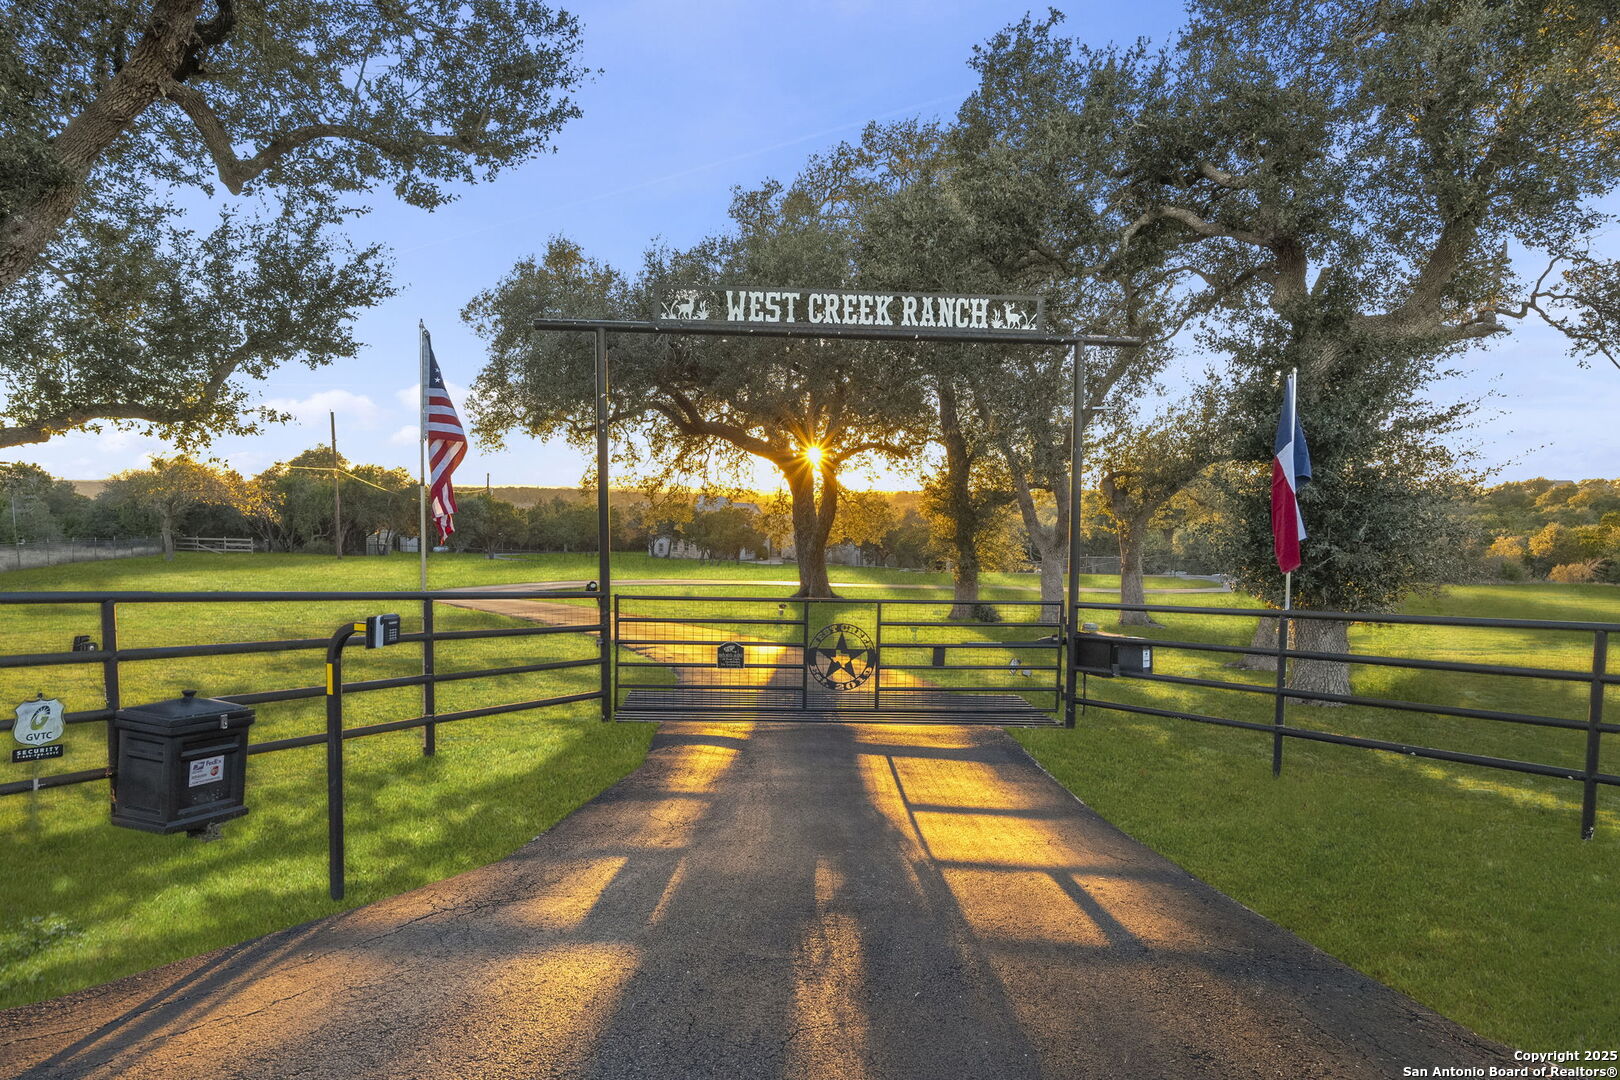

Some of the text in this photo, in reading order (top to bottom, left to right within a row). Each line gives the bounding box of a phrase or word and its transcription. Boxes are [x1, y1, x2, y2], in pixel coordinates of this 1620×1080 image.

[726, 290, 989, 329] WEST CREEK RANCH
[26, 731, 53, 742] GVTC
[16, 746, 60, 756] SECURITY
